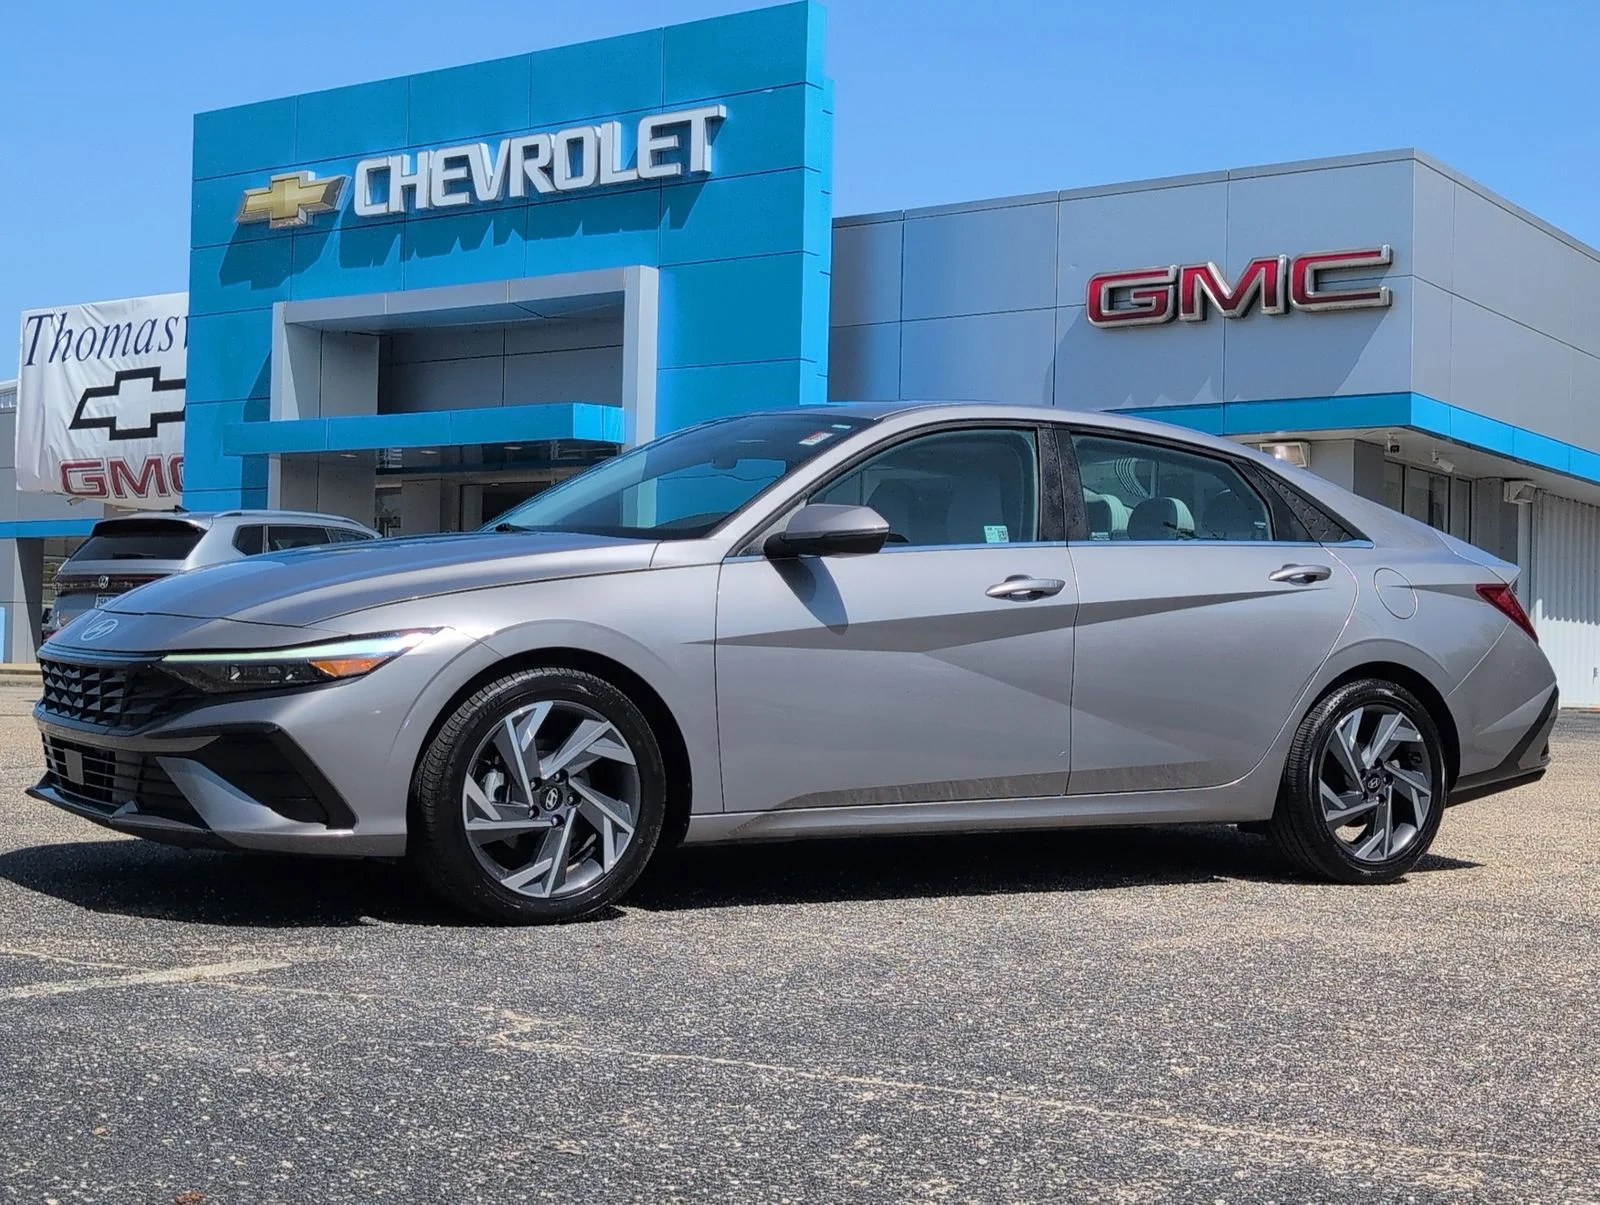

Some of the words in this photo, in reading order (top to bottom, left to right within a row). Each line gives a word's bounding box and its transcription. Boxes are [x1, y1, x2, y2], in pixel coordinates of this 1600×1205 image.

[354, 104, 727, 217] CHEVROLET
[1086, 244, 1393, 328] GMC
[24, 312, 189, 367] Thomas
